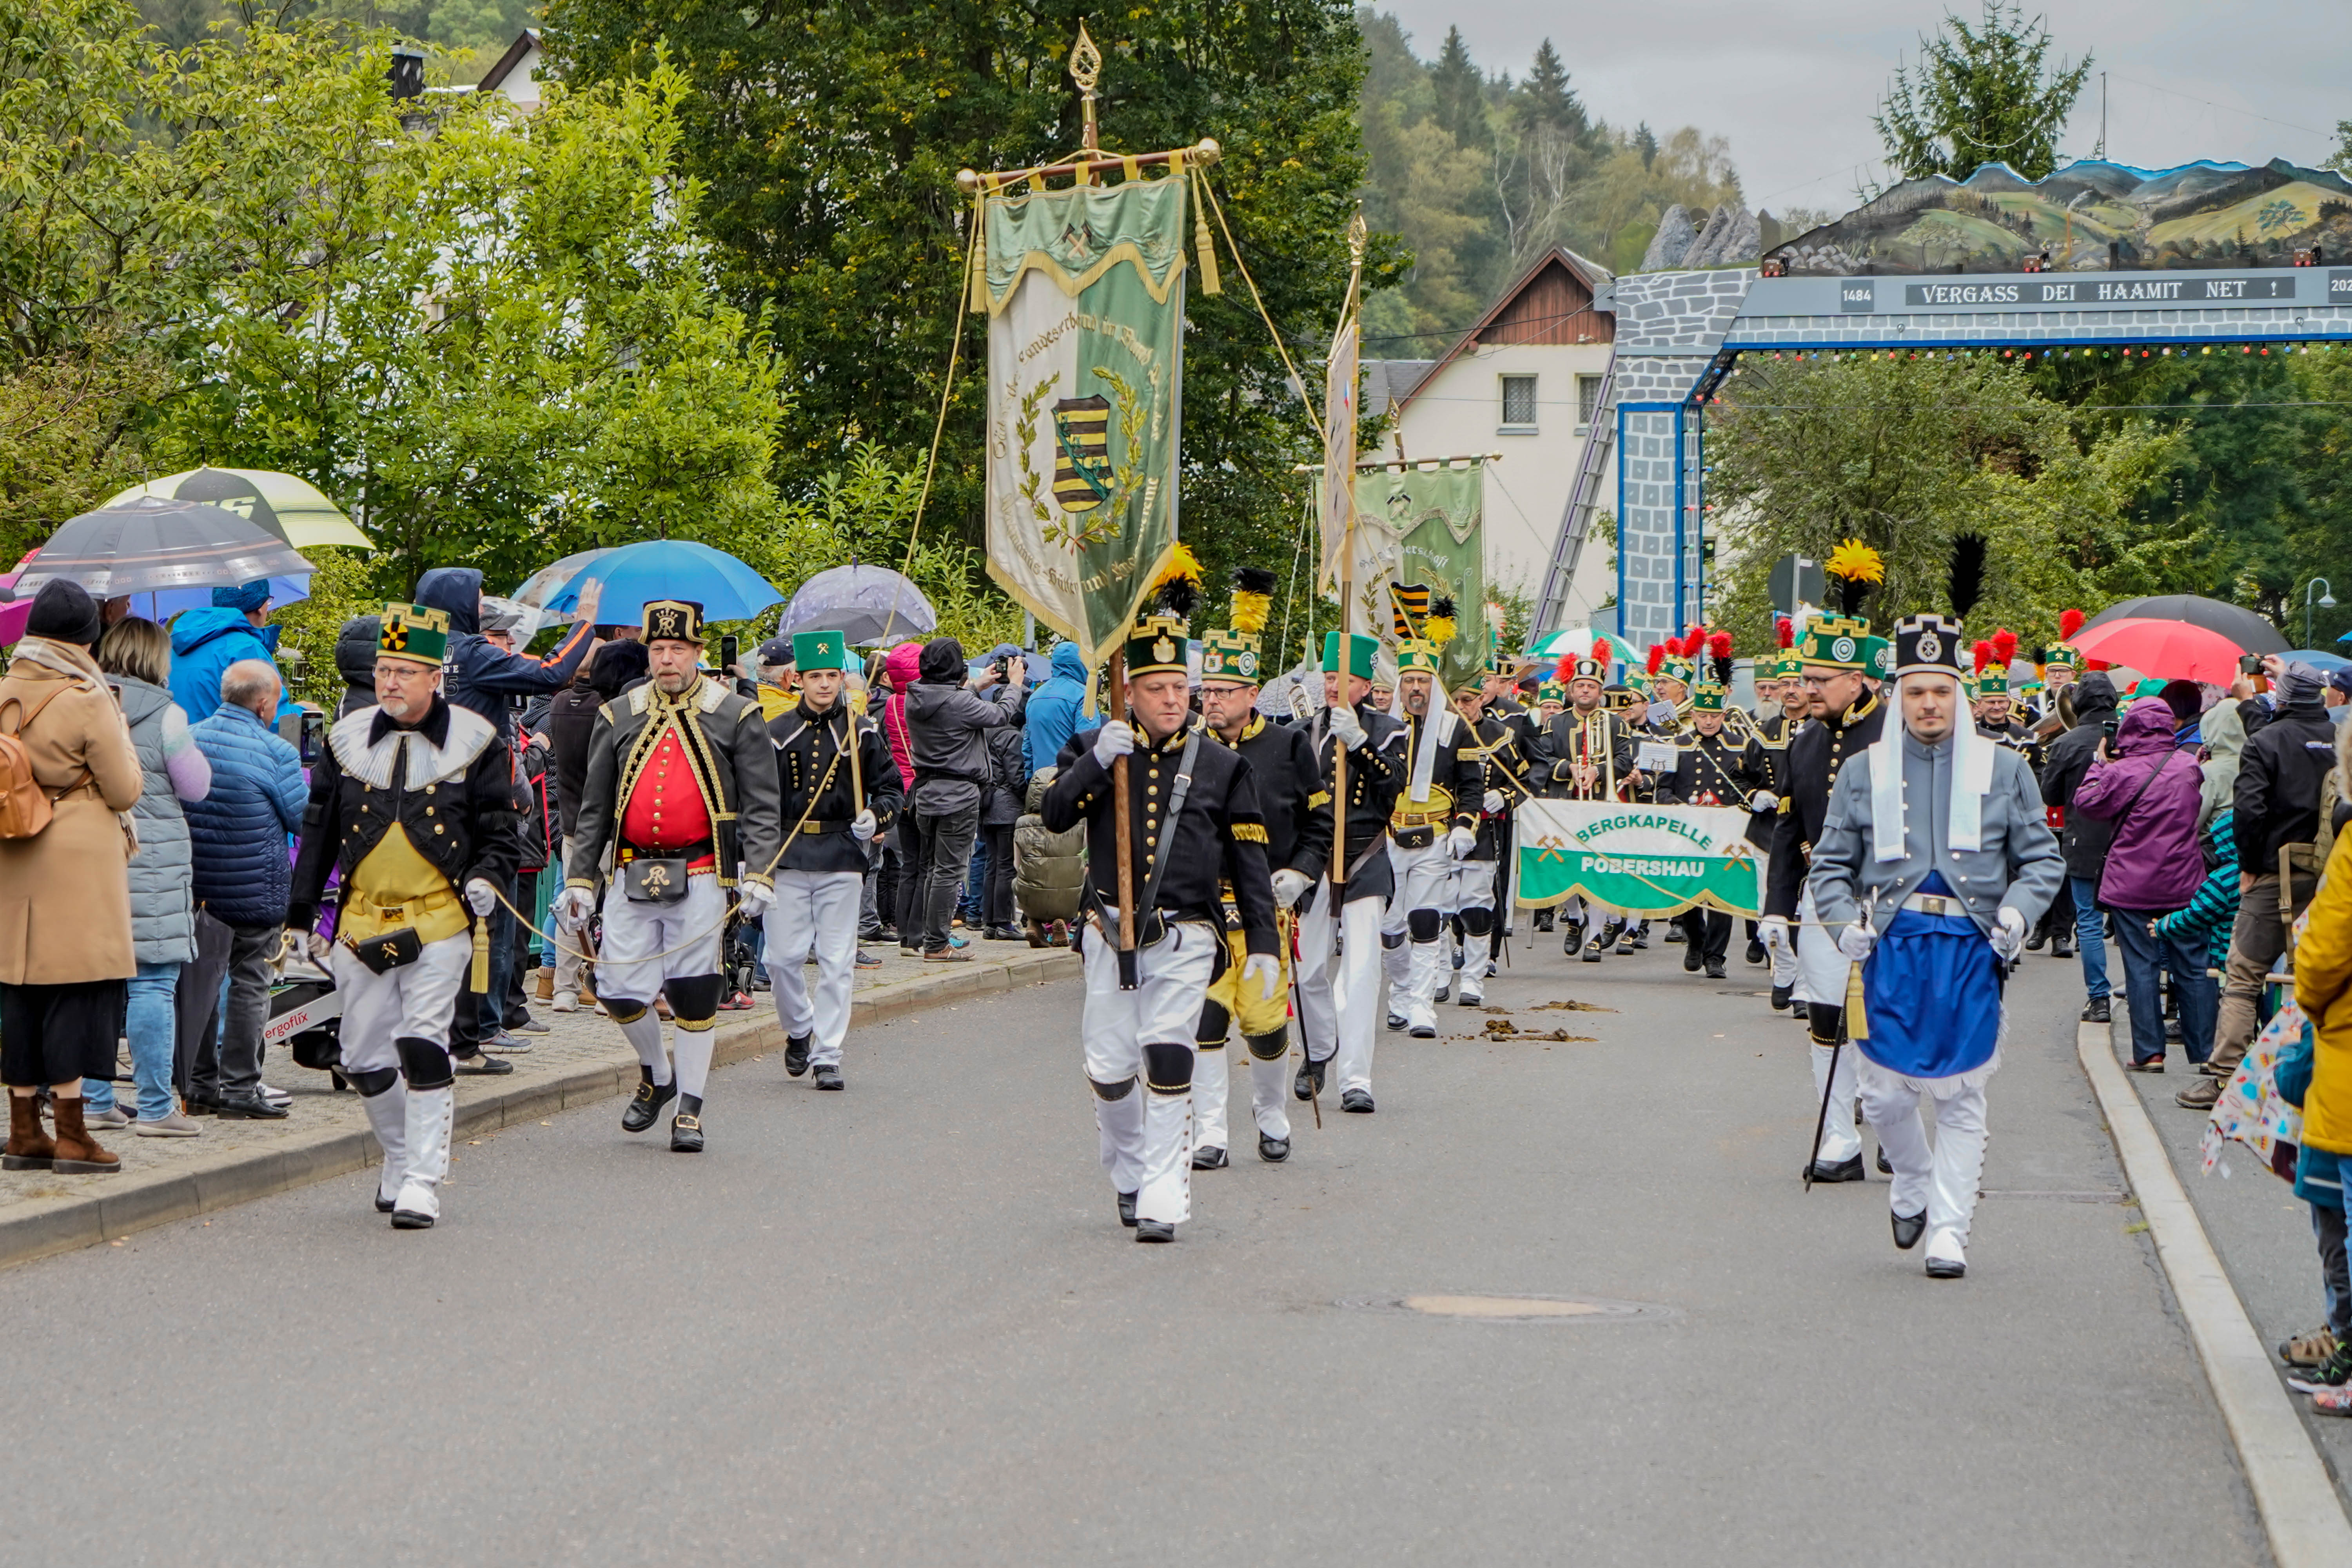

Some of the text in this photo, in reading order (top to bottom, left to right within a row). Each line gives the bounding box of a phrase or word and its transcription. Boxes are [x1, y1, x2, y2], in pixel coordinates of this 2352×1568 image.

[1843, 289, 1871, 301] 1484
[1922, 285, 2019, 303] VERGASS
[2042, 285, 2076, 301] DEI
[2098, 282, 2182, 300] HAAMIT
[2206, 281, 2247, 298] NET
[1576, 815, 1712, 851] BERGKAPELLE
[1581, 856, 1704, 877] POBERSHAU
[265, 1011, 309, 1039] ergoflix
